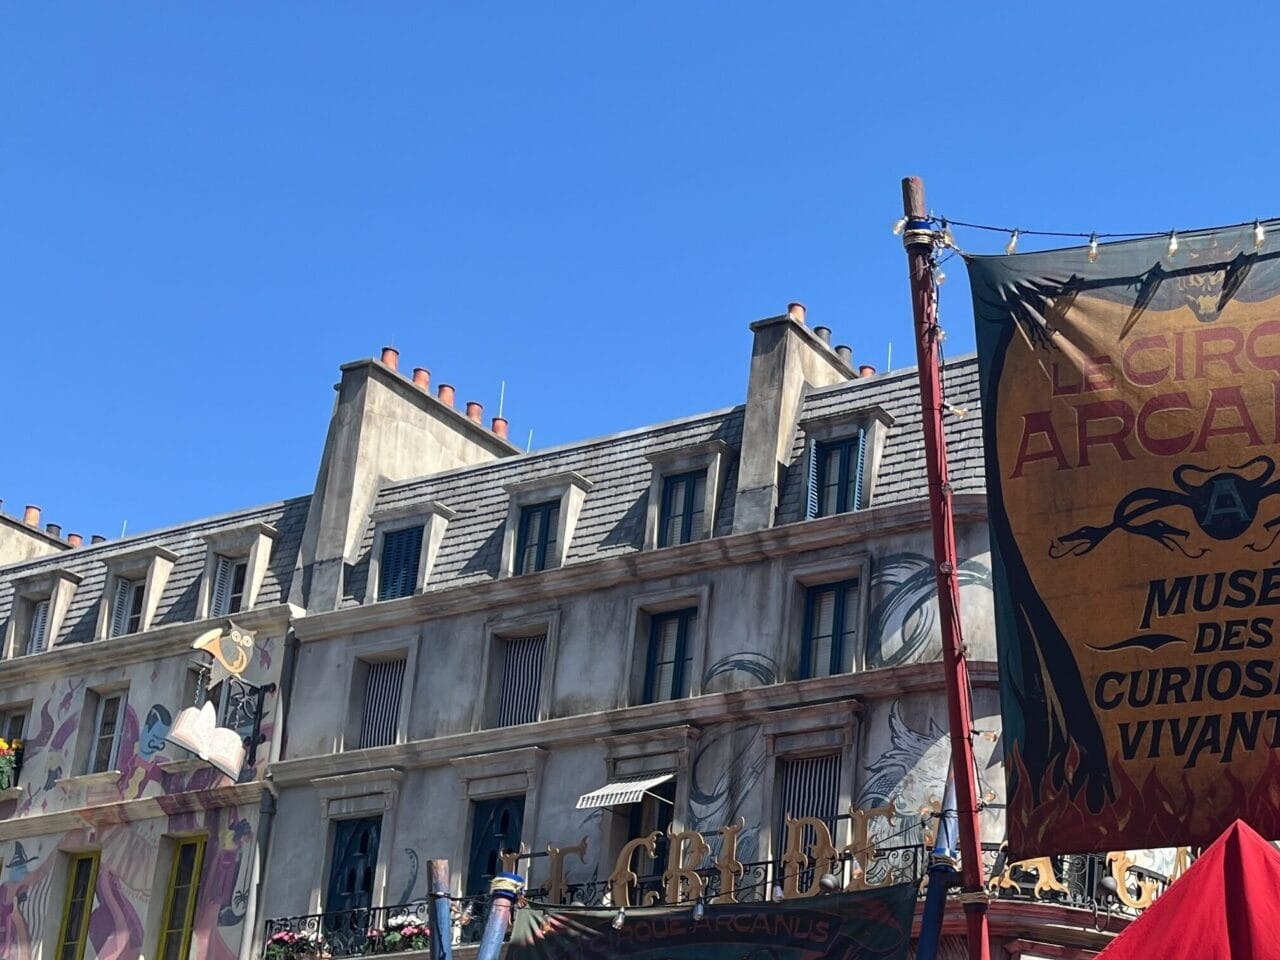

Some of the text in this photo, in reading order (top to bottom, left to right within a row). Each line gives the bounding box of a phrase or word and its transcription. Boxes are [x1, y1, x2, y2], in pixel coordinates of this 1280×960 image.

[1048, 355, 1115, 398] LE
[1206, 479, 1250, 525] A
[1192, 616, 1274, 655] DES
[607, 815, 745, 906] CRI
[781, 797, 896, 901] DE
[692, 911, 831, 942] ARCANUS
